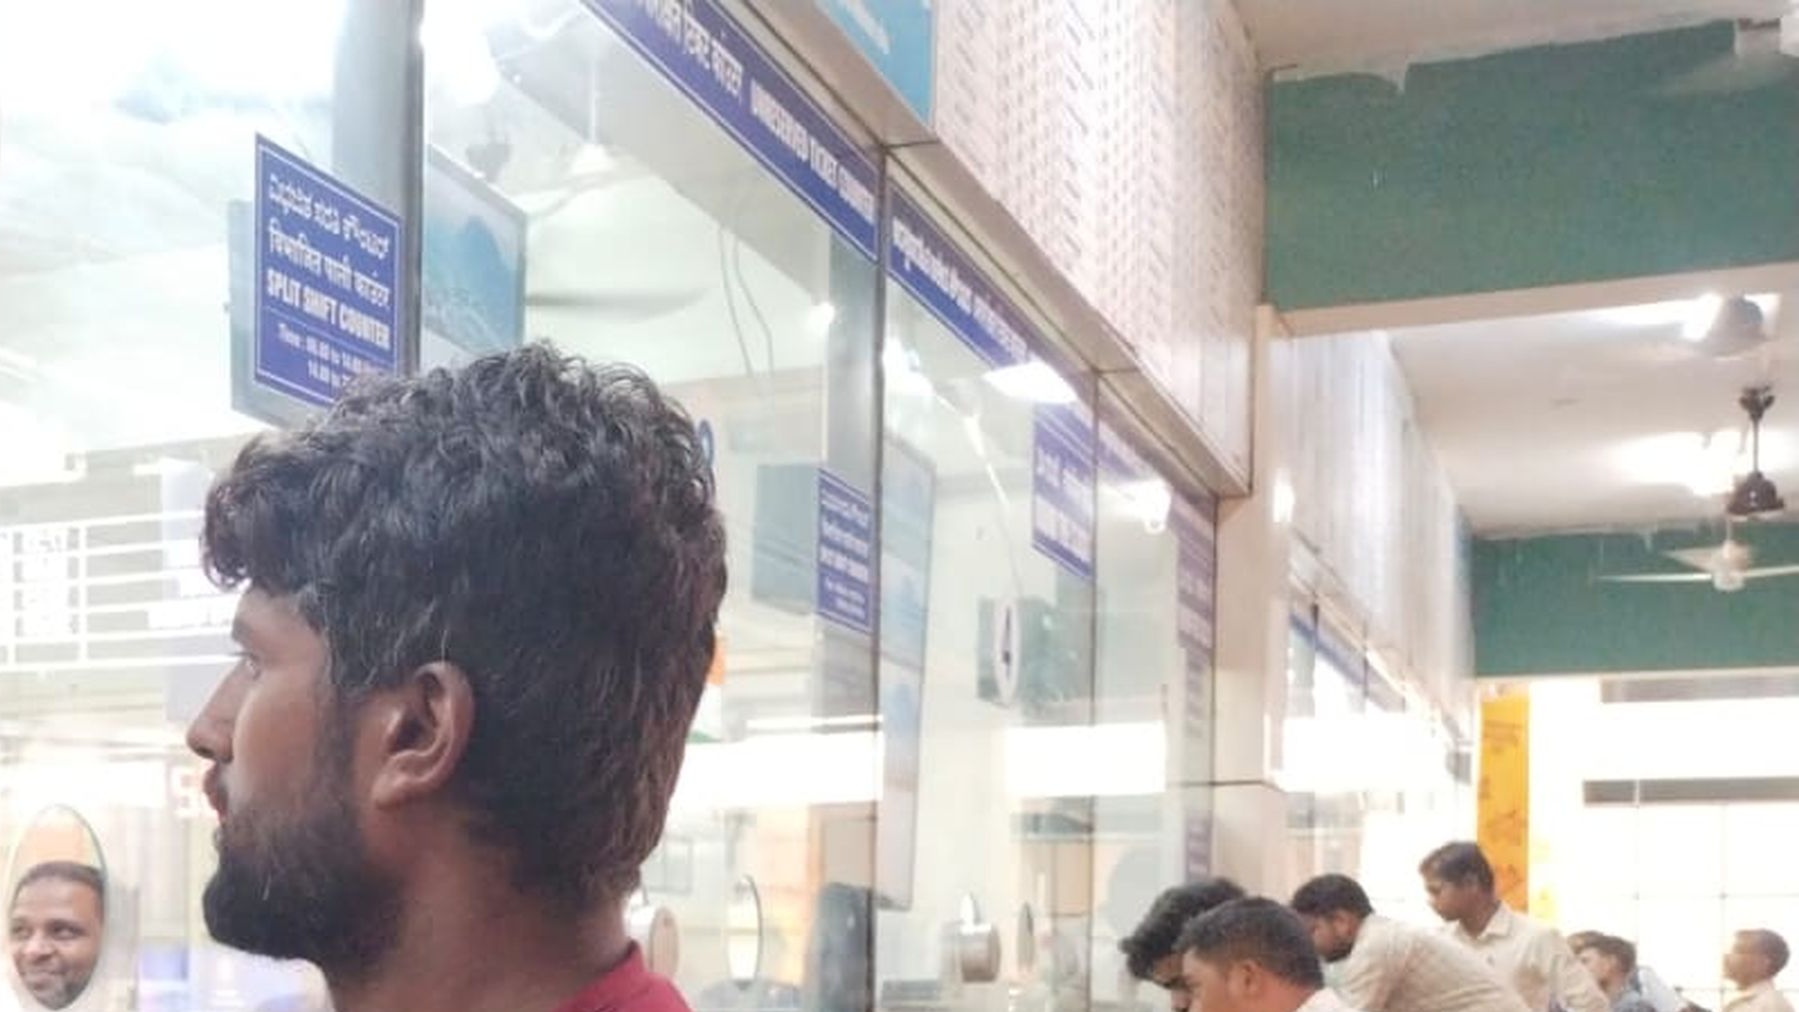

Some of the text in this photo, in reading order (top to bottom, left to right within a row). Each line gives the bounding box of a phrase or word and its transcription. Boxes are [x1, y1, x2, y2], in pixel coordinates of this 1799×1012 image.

[268, 268, 390, 350] SPLIT SHIFT COUNTER
